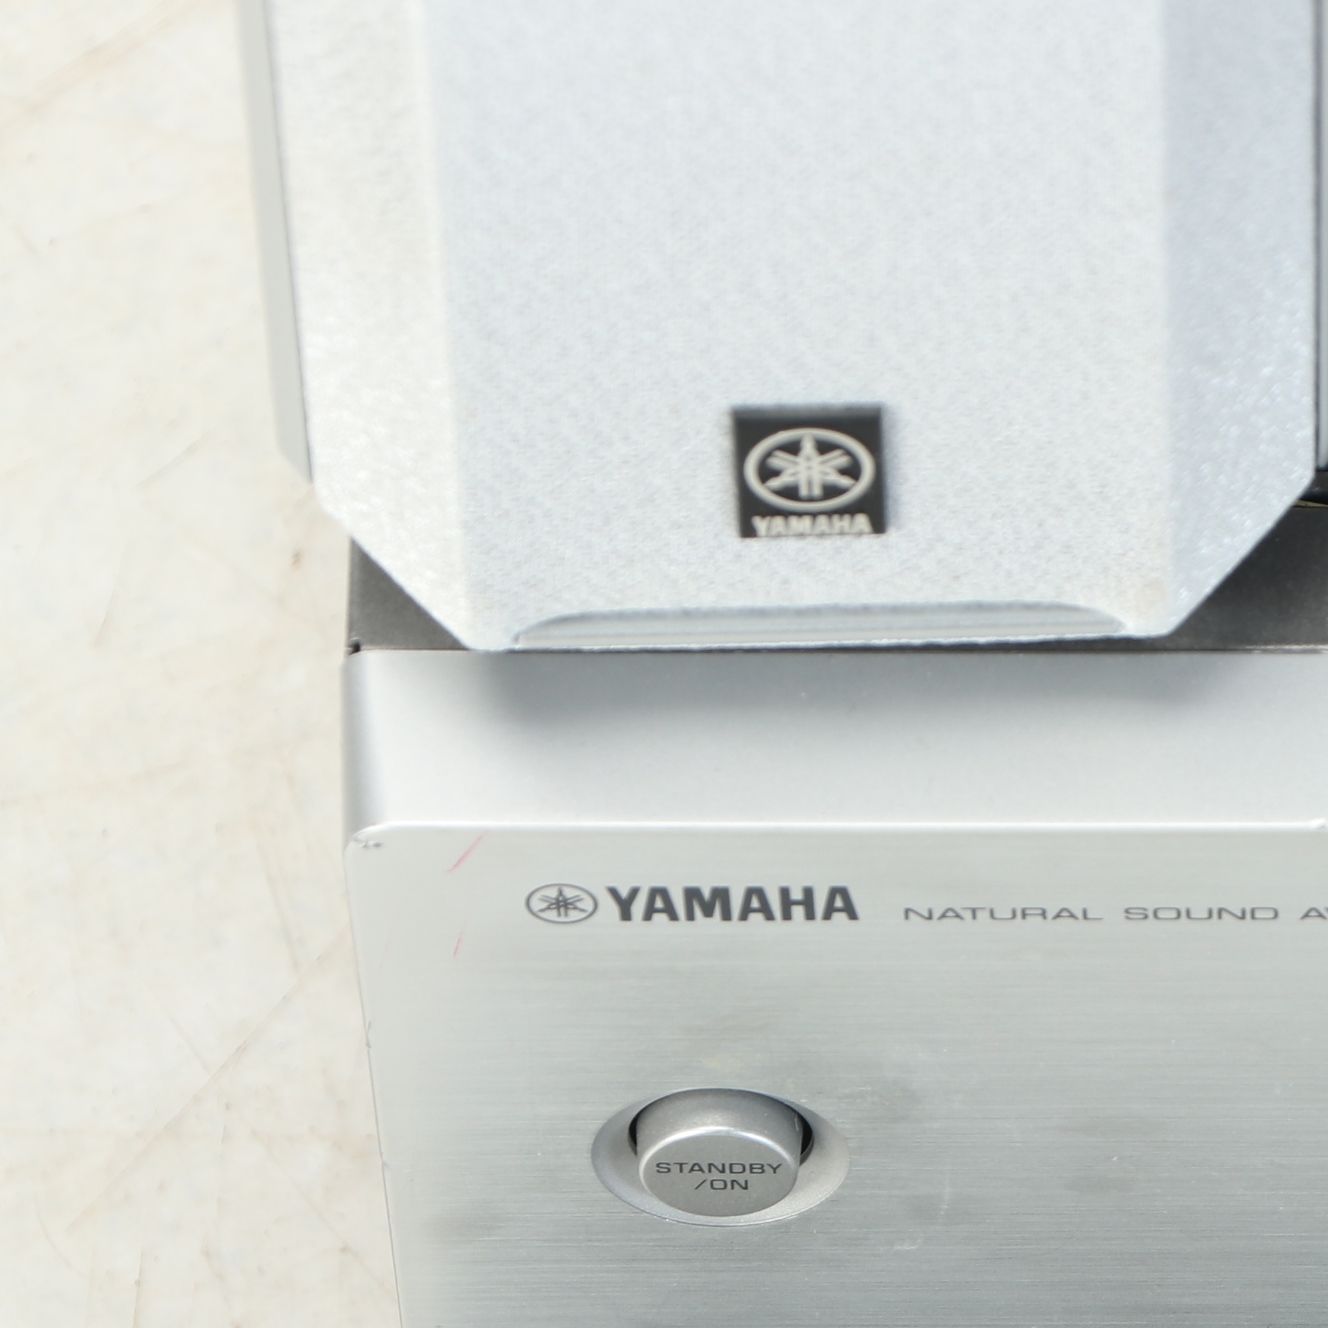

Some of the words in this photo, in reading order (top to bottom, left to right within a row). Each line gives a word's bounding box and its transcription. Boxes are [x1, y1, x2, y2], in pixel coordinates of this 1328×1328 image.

[751, 513, 874, 537] YAMAHA
[606, 885, 860, 922] YAMAHA
[904, 906, 1103, 921] NATURAL
[1124, 906, 1279, 921] SOUND
[655, 1161, 782, 1174] STANDBY
